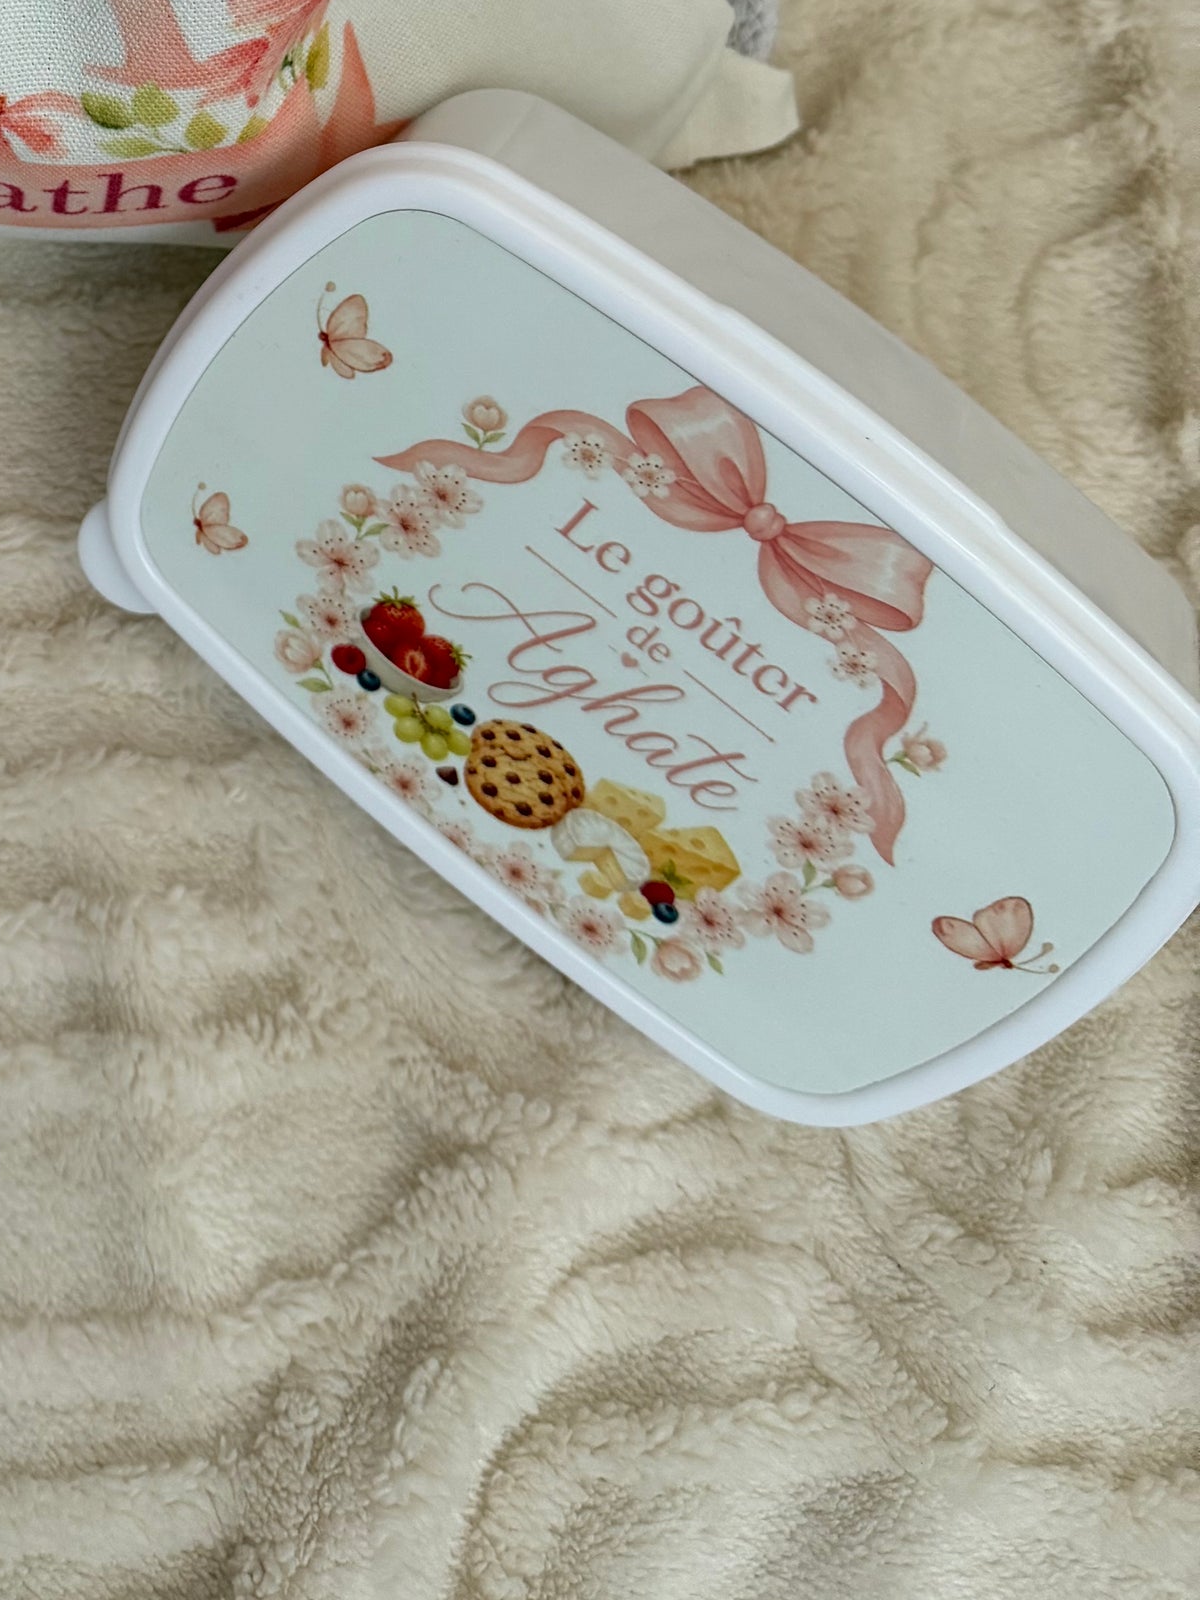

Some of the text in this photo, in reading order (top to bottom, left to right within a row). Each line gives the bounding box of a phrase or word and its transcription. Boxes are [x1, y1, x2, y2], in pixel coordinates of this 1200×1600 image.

[429, 583, 759, 810] Aghate
[554, 498, 818, 712] Le goûter
[626, 624, 671, 663] de
